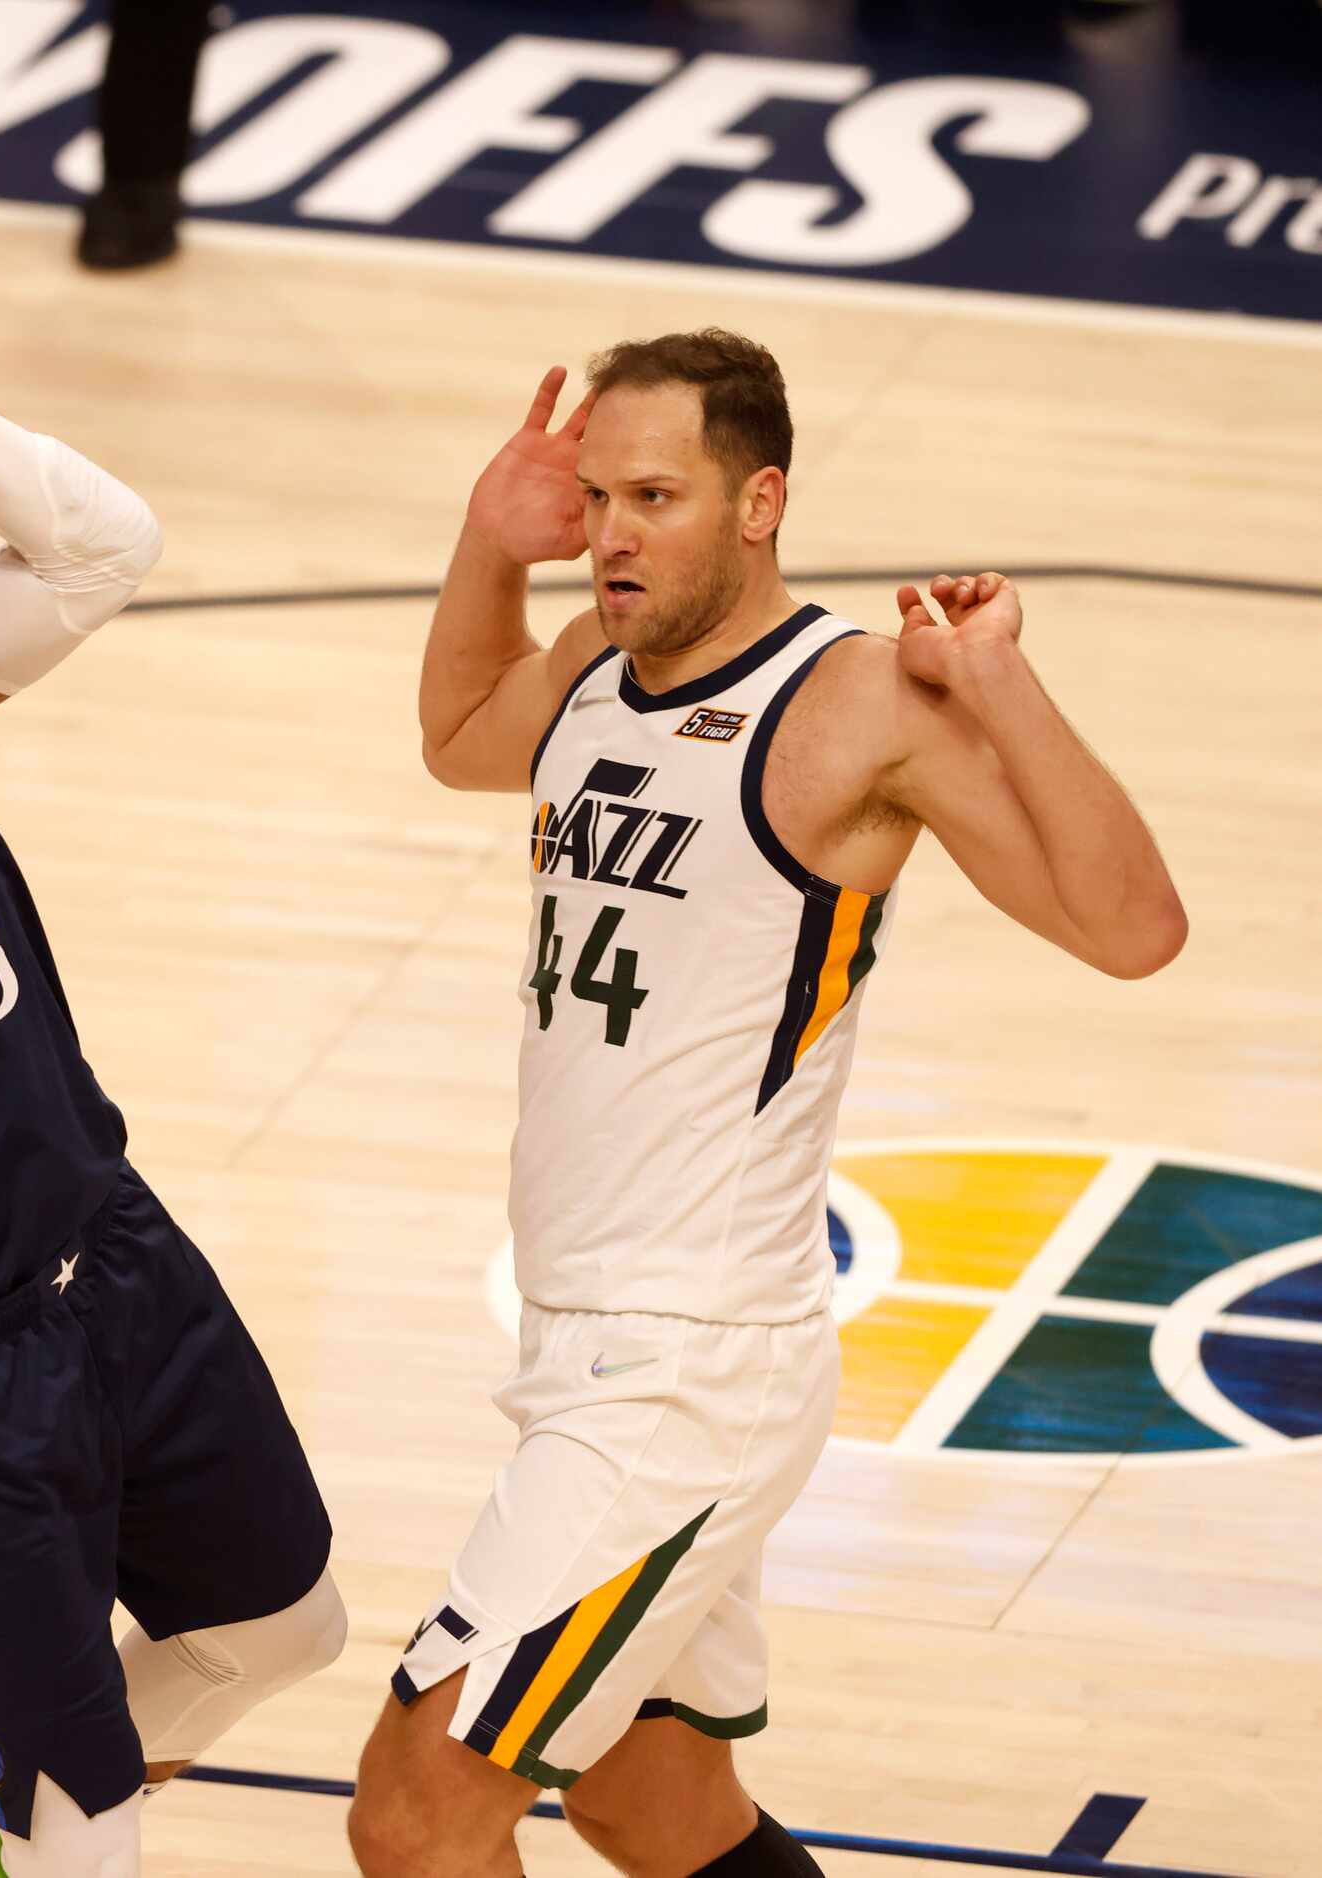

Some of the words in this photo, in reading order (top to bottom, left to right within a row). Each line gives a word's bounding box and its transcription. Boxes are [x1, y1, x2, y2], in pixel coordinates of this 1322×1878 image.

[681, 711, 710, 735] 5
[698, 725, 738, 740] FIGHT
[531, 758, 703, 900] JAZZ
[528, 894, 650, 1048] 44
